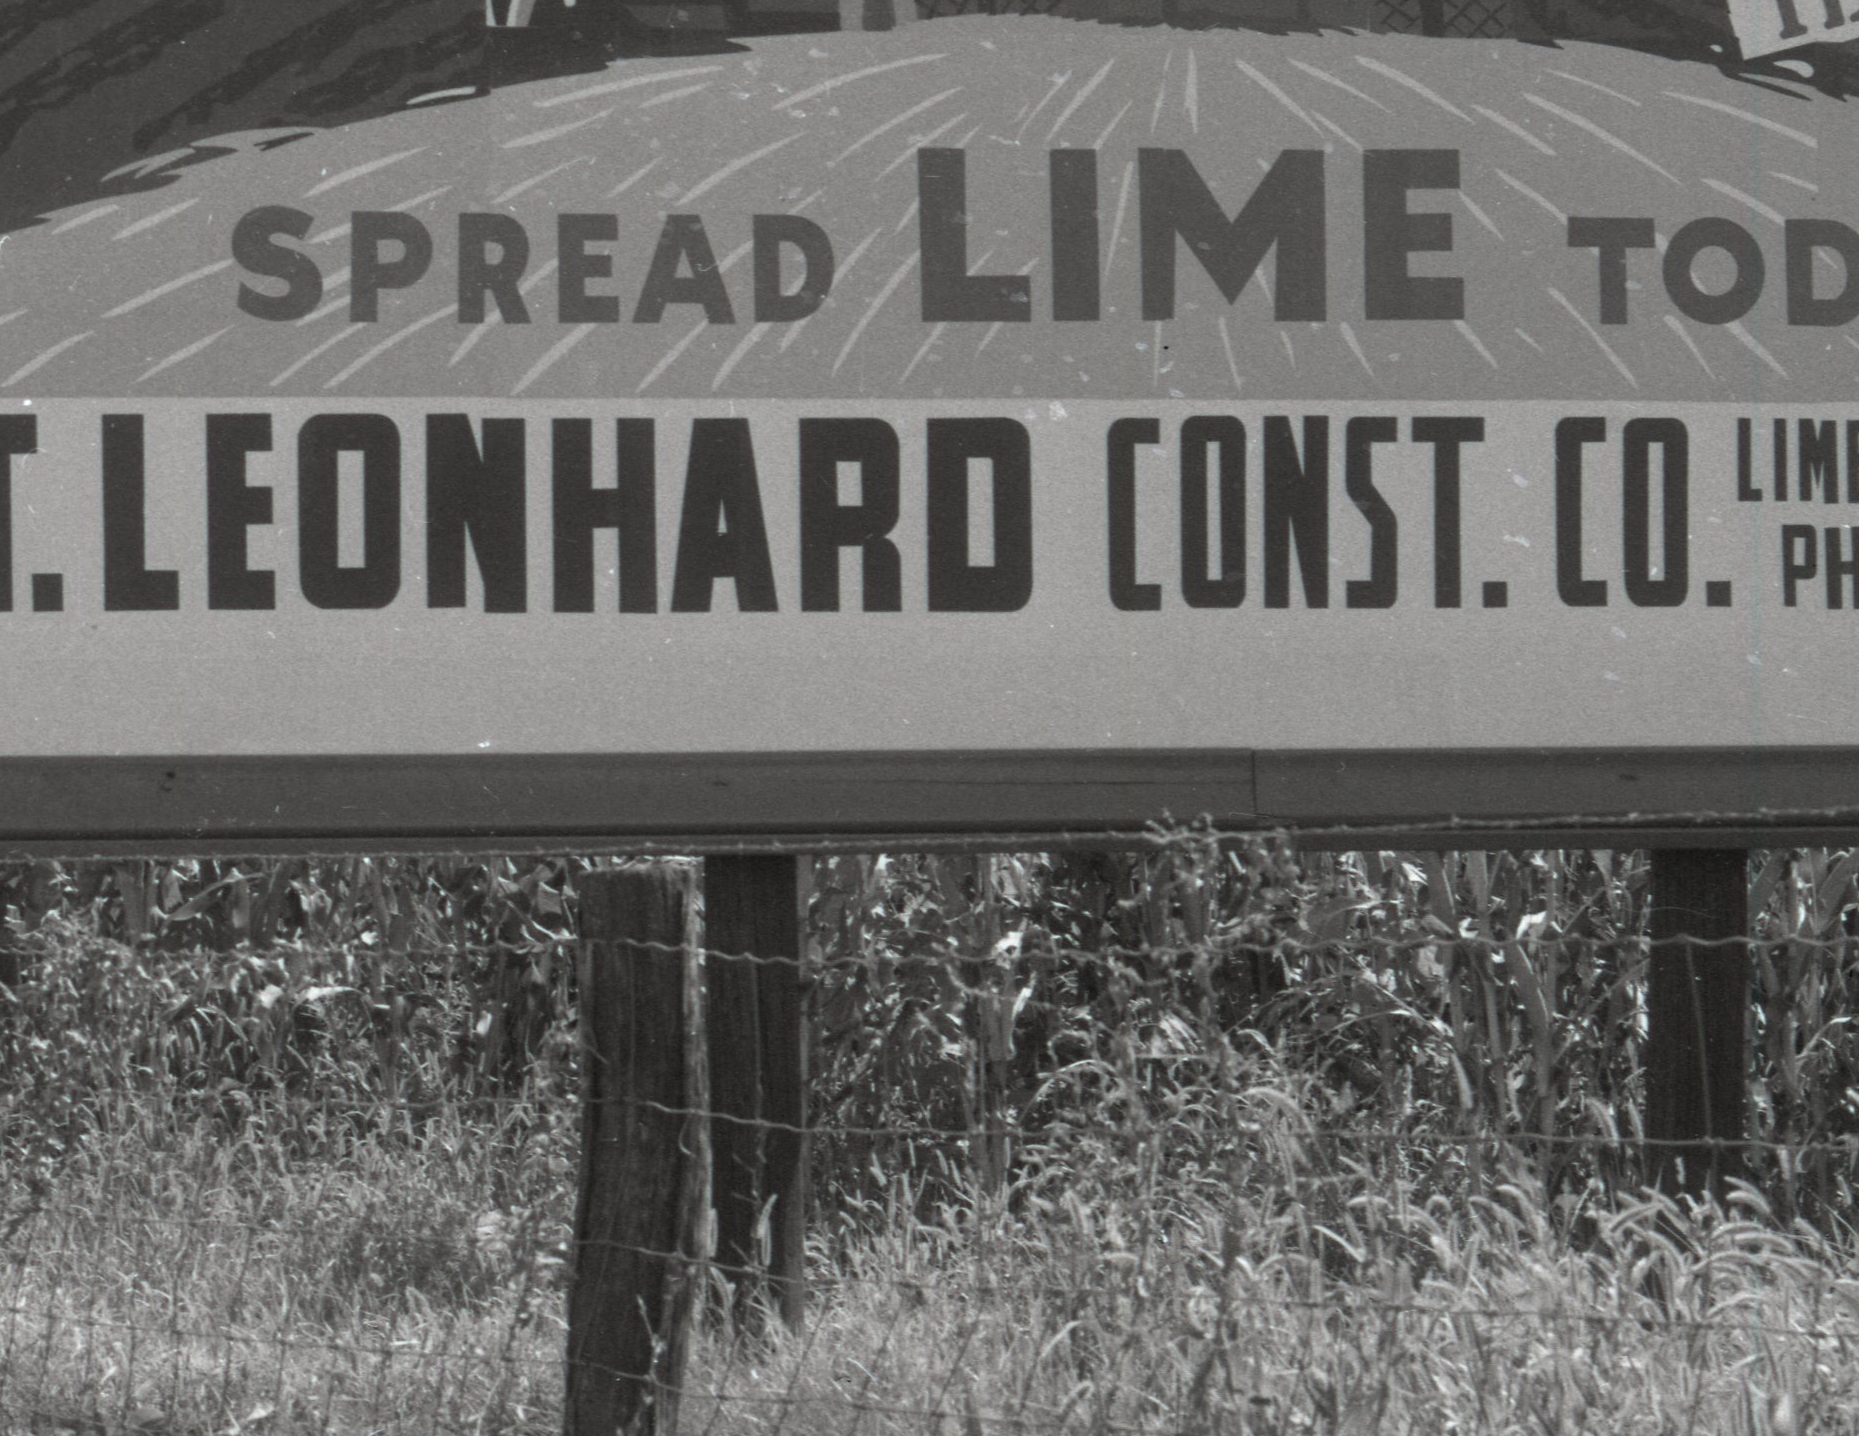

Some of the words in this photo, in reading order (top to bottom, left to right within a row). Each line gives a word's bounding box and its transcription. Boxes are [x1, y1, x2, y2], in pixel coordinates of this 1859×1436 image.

[230, 204, 836, 326] SPREAD
[916, 147, 1466, 324] LIME
[1105, 414, 1509, 612] CONST.
[1553, 416, 1733, 608] CO.
